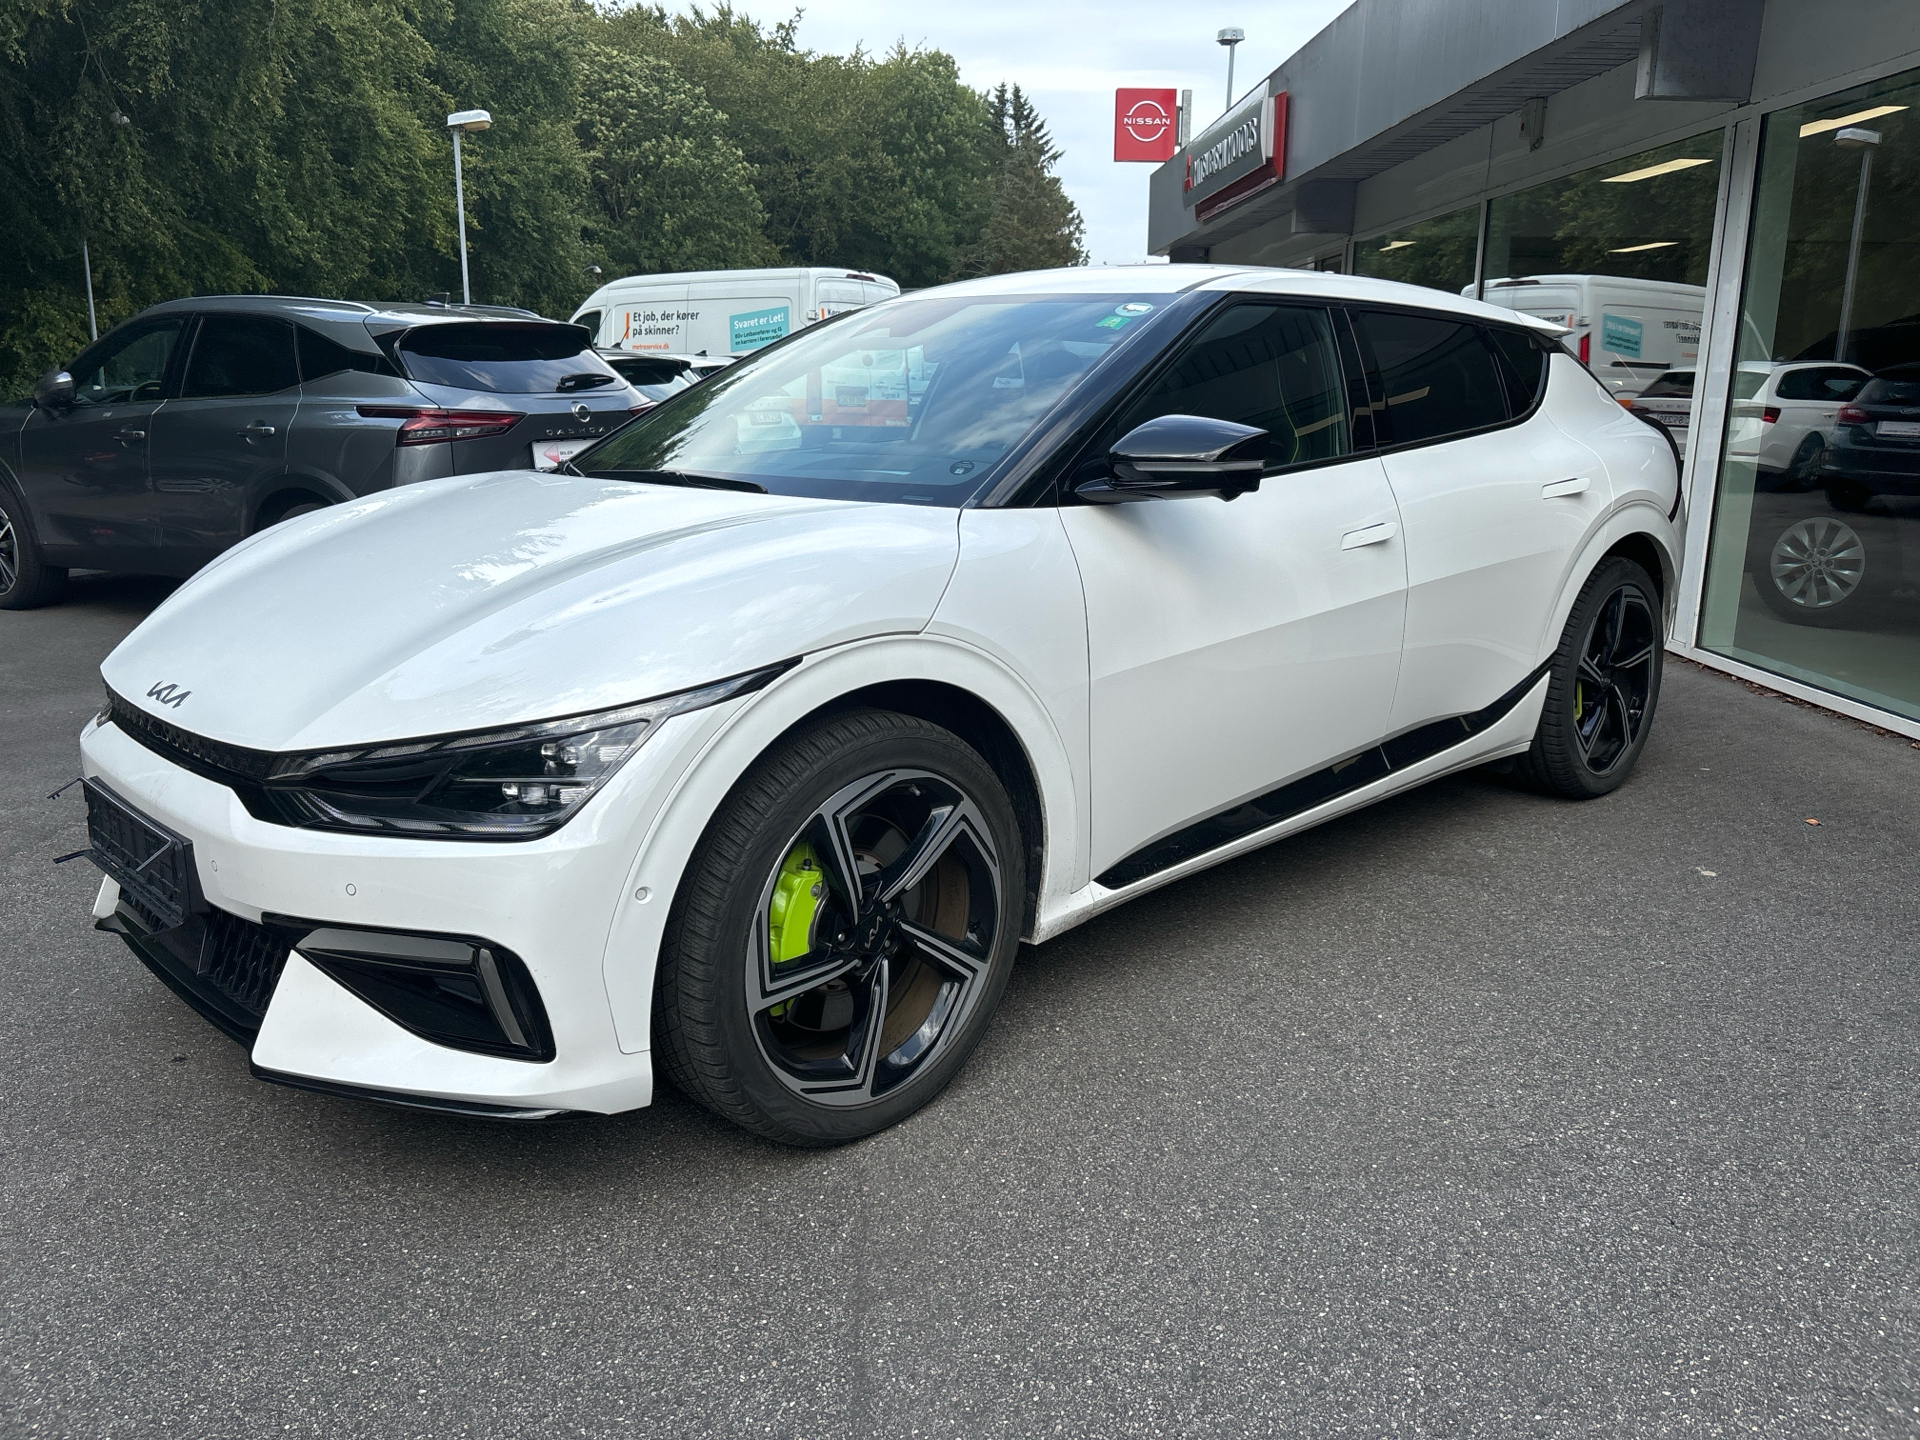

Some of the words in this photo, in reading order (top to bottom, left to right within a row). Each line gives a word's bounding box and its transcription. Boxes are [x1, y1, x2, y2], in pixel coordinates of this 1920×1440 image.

[1123, 117, 1170, 125] NISSAN
[633, 312, 642, 322] Et
[642, 311, 659, 324] job,
[660, 310, 675, 321] der
[676, 310, 700, 321] kører
[734, 317, 759, 330] Svaret
[759, 317, 768, 325] er
[769, 312, 785, 324] Let!
[632, 325, 643, 338] på
[644, 324, 680, 336] skinner?
[146, 679, 193, 709] KIA
